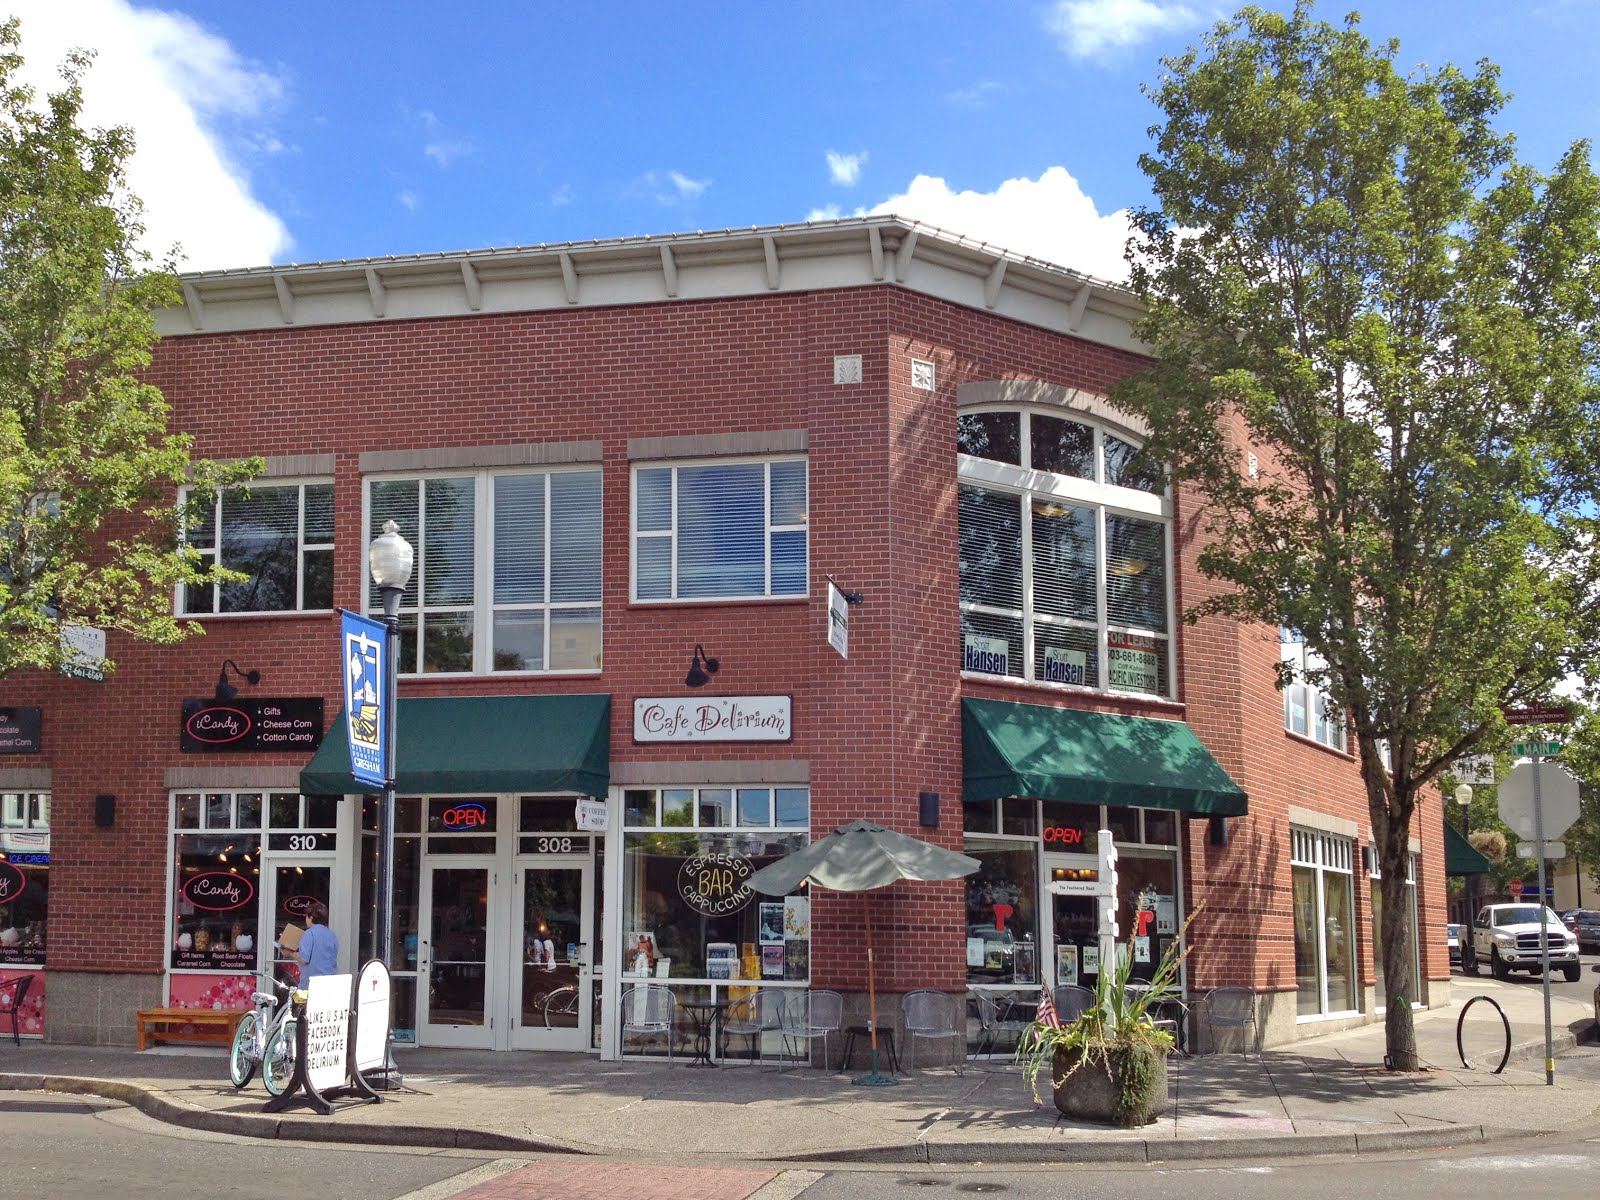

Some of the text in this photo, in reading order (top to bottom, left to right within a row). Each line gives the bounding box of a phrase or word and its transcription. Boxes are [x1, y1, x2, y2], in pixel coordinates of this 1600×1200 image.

[1127, 633, 1156, 649] LEASE
[966, 645, 1007, 673] Hansen
[1045, 656, 1084, 685] Hansen
[1108, 668, 1127, 684] ACIFIC
[263, 707, 281, 716] Gifts
[642, 702, 785, 737] Cafe Delirium
[196, 714, 239, 735] iCandy
[263, 719, 313, 729] Cheese Corn
[15, 738, 32, 746] Corn
[262, 732, 314, 743] Cotton Candy
[1523, 742, 1550, 756] MAIN
[354, 757, 380, 774] GRESHAM
[443, 809, 487, 825] OPEN
[289, 835, 316, 850] 310
[1043, 826, 1083, 844] OPEN
[538, 838, 572, 853] 308
[9, 854, 23, 863] ICE
[685, 852, 749, 878] ESPRESSO
[698, 867, 734, 896] BAR
[193, 878, 241, 903] iCandy
[289, 898, 311, 909] iCand
[683, 885, 751, 913] CAPPUCCINO
[176, 960, 198, 968] Caramel
[309, 1011, 324, 1025] LIKE
[307, 1055, 340, 1070] DELIRIUM
